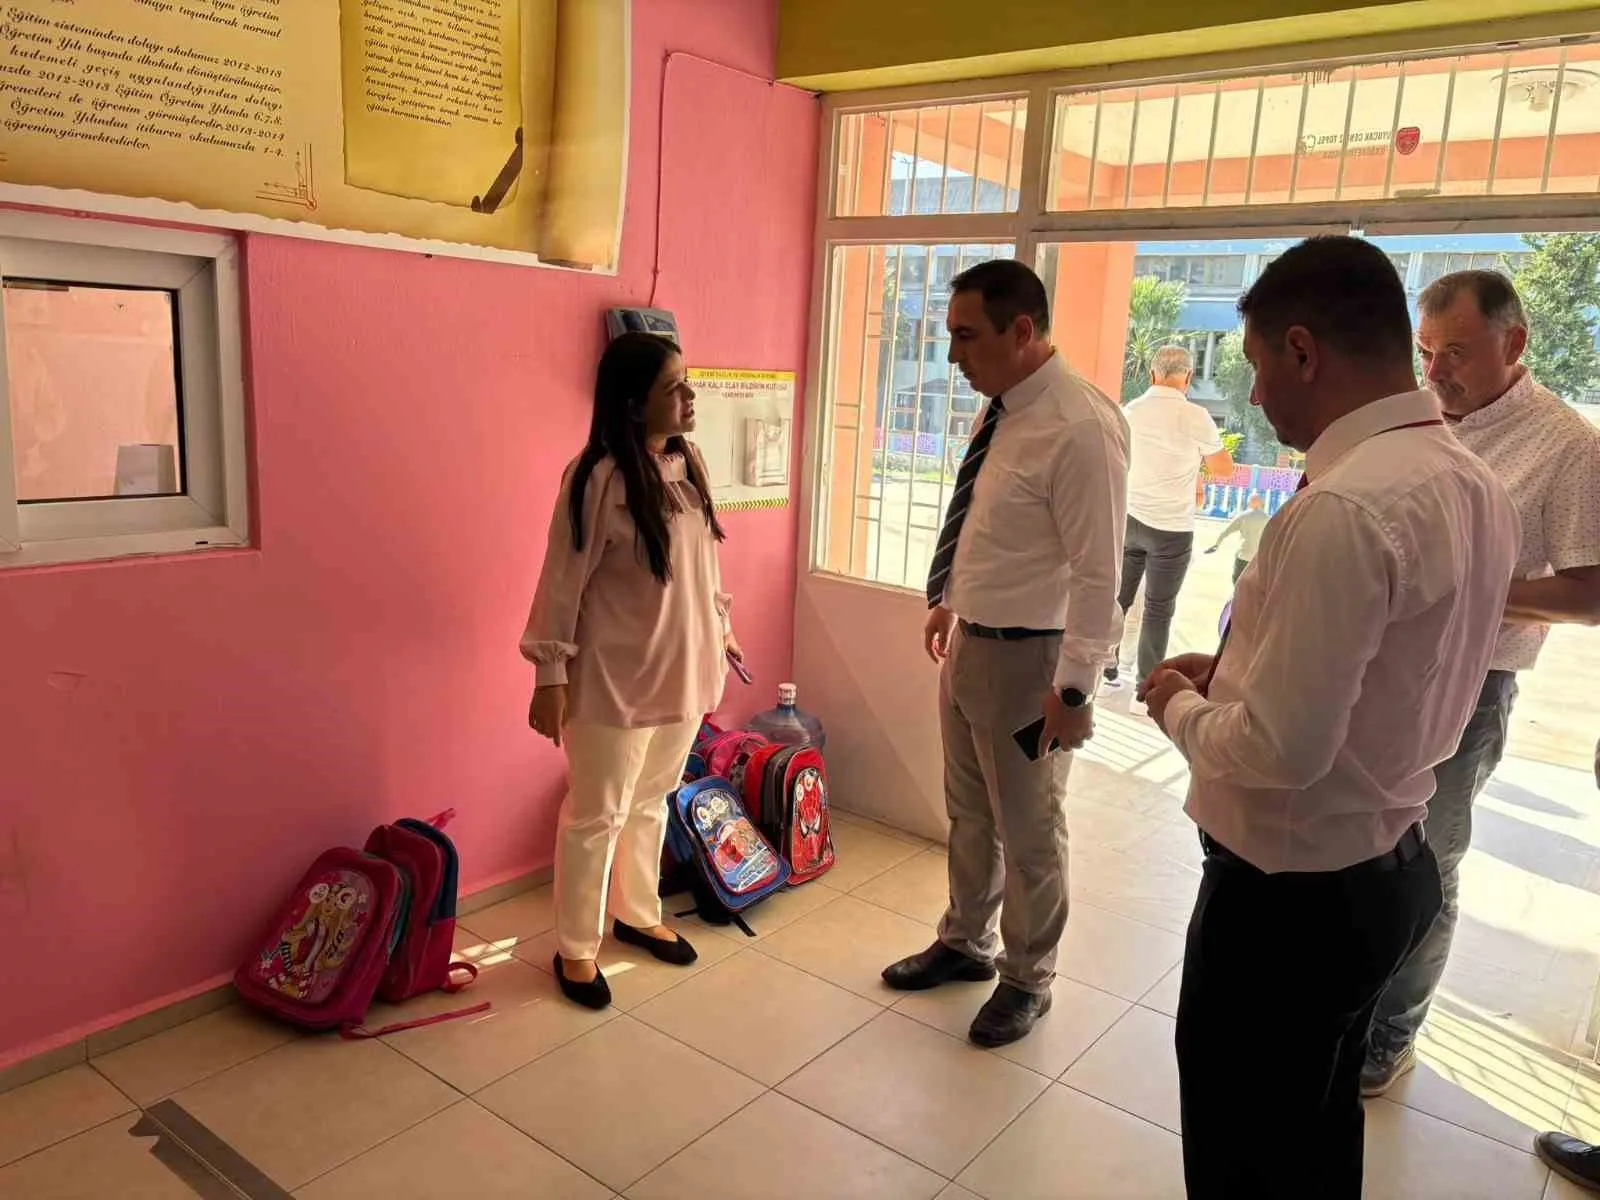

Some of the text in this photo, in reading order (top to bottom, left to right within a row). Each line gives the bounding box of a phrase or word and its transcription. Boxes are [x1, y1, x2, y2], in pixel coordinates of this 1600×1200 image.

[7, 7, 50, 26] Eğitim
[53, 21, 124, 42] sisteminden
[242, 23, 282, 38] normal
[10, 44, 78, 68] kademeli
[82, 64, 120, 79] geçiş
[38, 70, 110, 91] 2012-2013
[0, 80, 61, 99] ğrencileri
[68, 93, 83, 104] de
[10, 97, 64, 118] Öğretim
